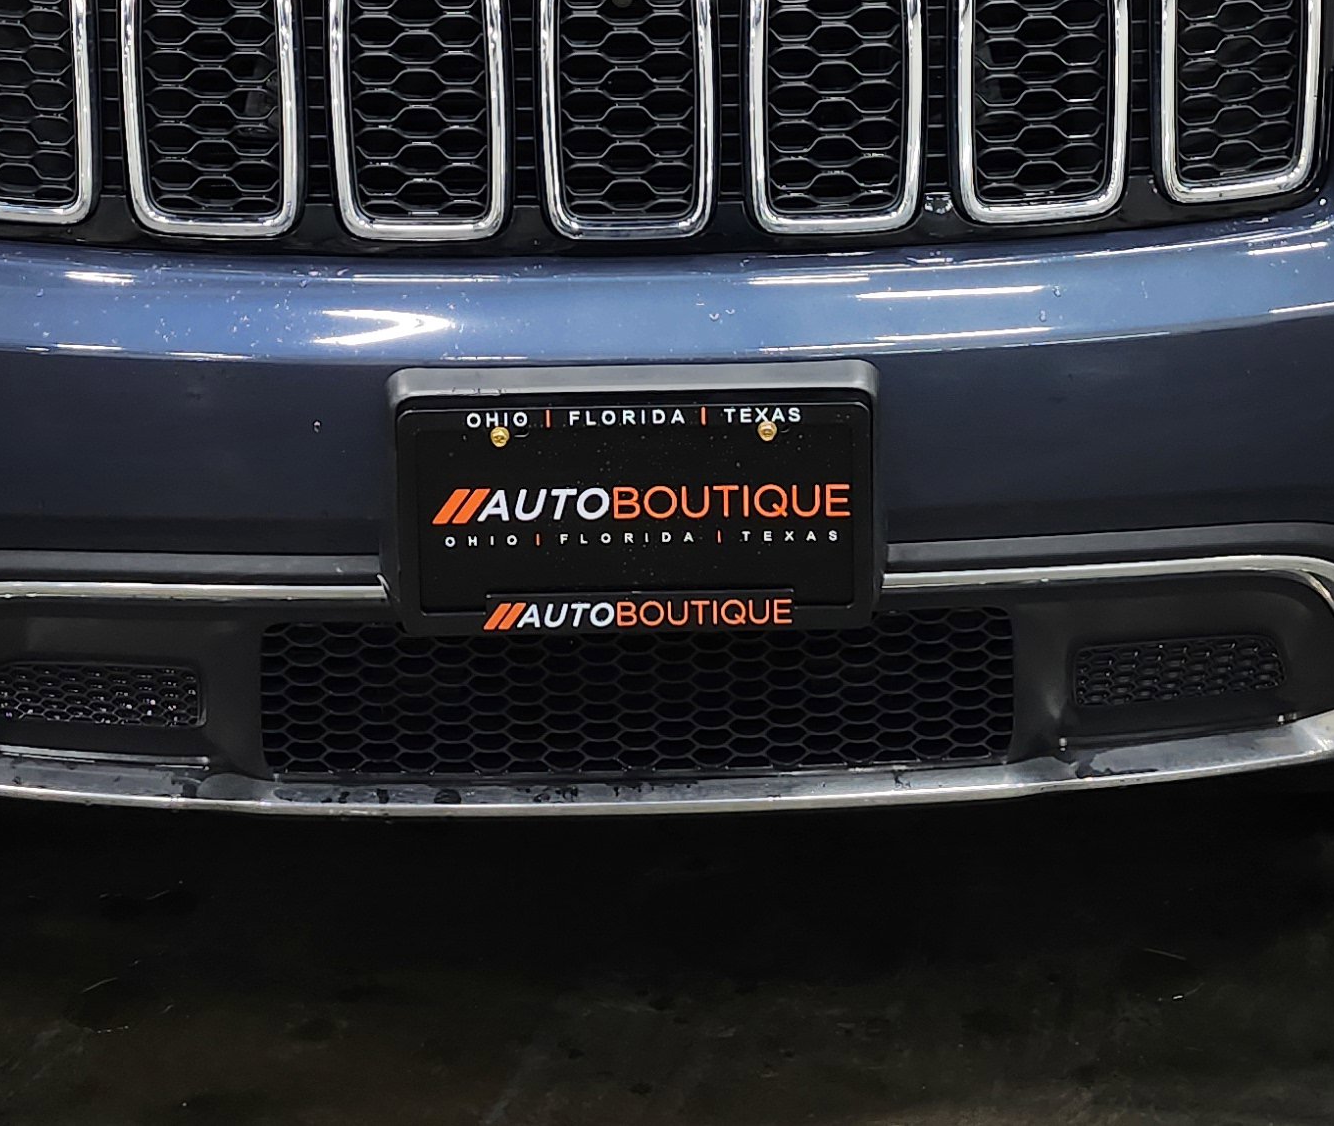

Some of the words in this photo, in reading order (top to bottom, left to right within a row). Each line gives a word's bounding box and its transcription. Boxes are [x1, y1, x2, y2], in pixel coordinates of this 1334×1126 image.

[466, 410, 529, 429] OHIO
[568, 407, 686, 427] FLORIDA
[724, 405, 802, 424] TEXAS
[477, 482, 852, 523] AUTOBOUTIQUE
[444, 533, 519, 549] OHIO
[559, 530, 695, 546] FLORIDA
[741, 529, 839, 544] TEXAS
[517, 597, 793, 630] AUTOBOUTIQUE
